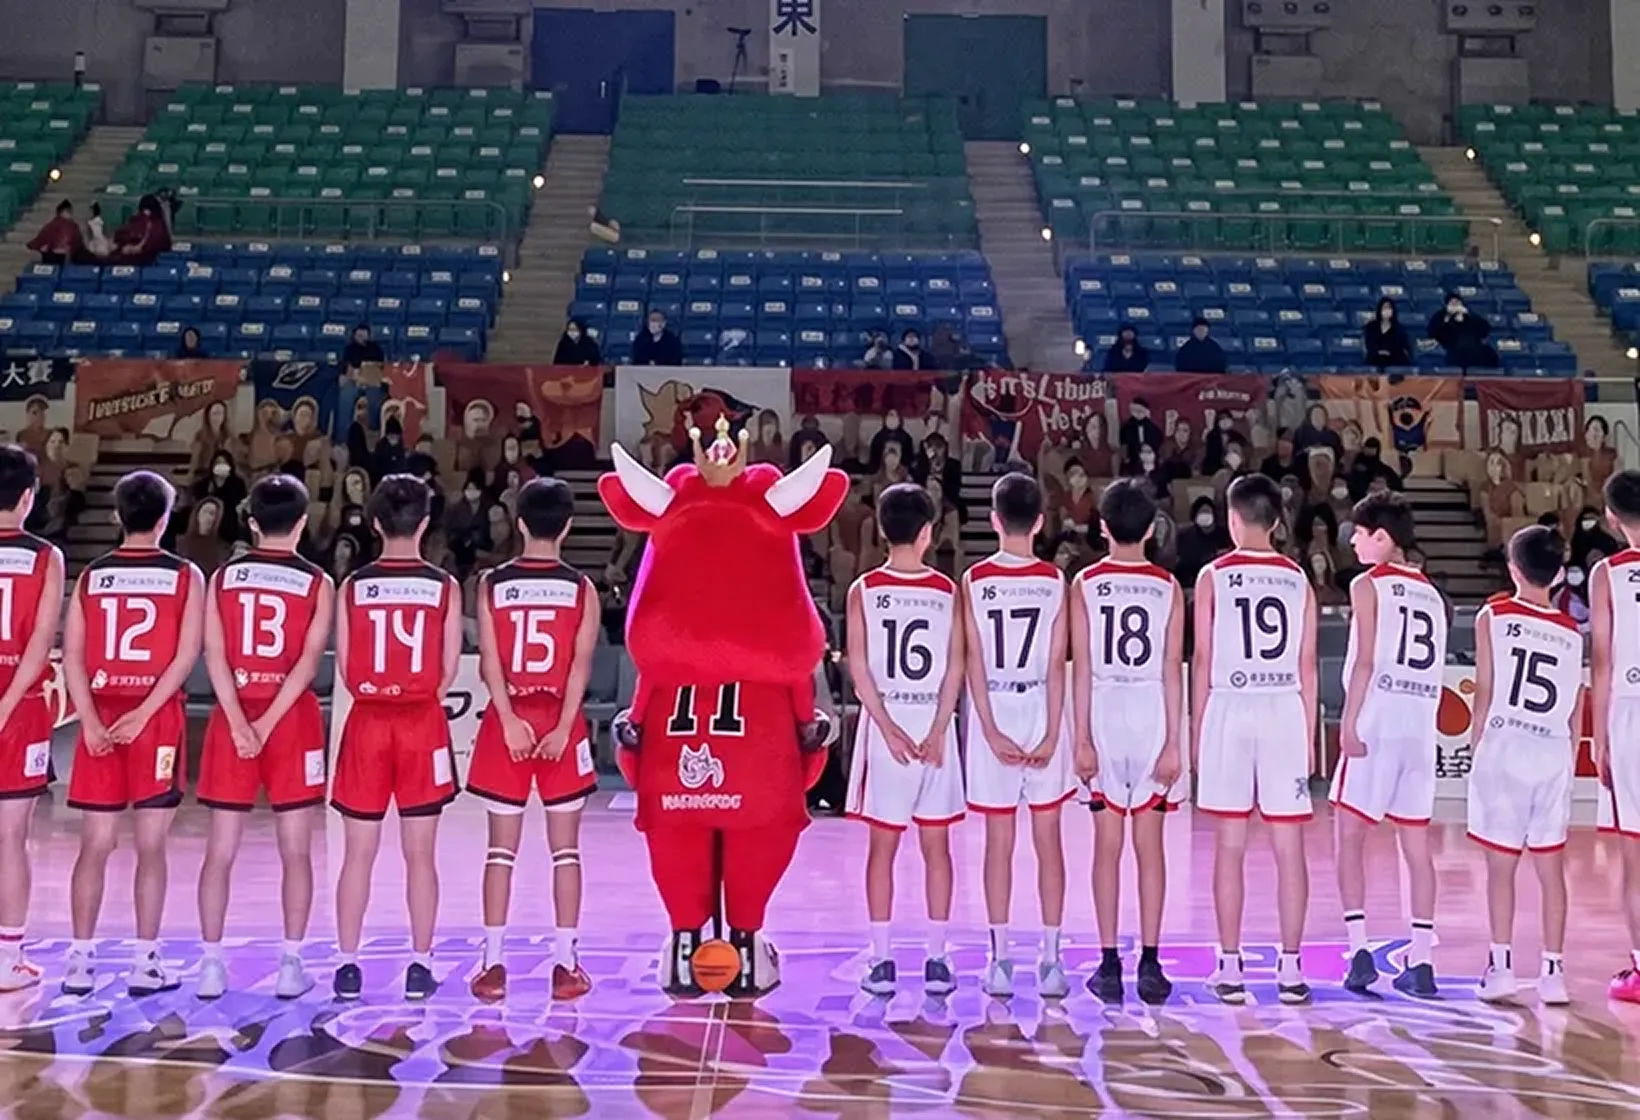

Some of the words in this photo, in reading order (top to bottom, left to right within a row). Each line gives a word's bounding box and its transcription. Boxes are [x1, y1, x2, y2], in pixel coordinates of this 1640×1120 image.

[100, 597, 157, 661] 12
[239, 592, 287, 658] 13
[369, 609, 426, 674] 14
[509, 610, 557, 673] 15
[882, 618, 933, 681] 16
[987, 607, 1041, 669] 17
[1100, 605, 1152, 667] 18
[1235, 596, 1289, 660] 19
[1396, 606, 1436, 670] 13
[666, 681, 746, 737] 11
[1508, 647, 1559, 714] 15
